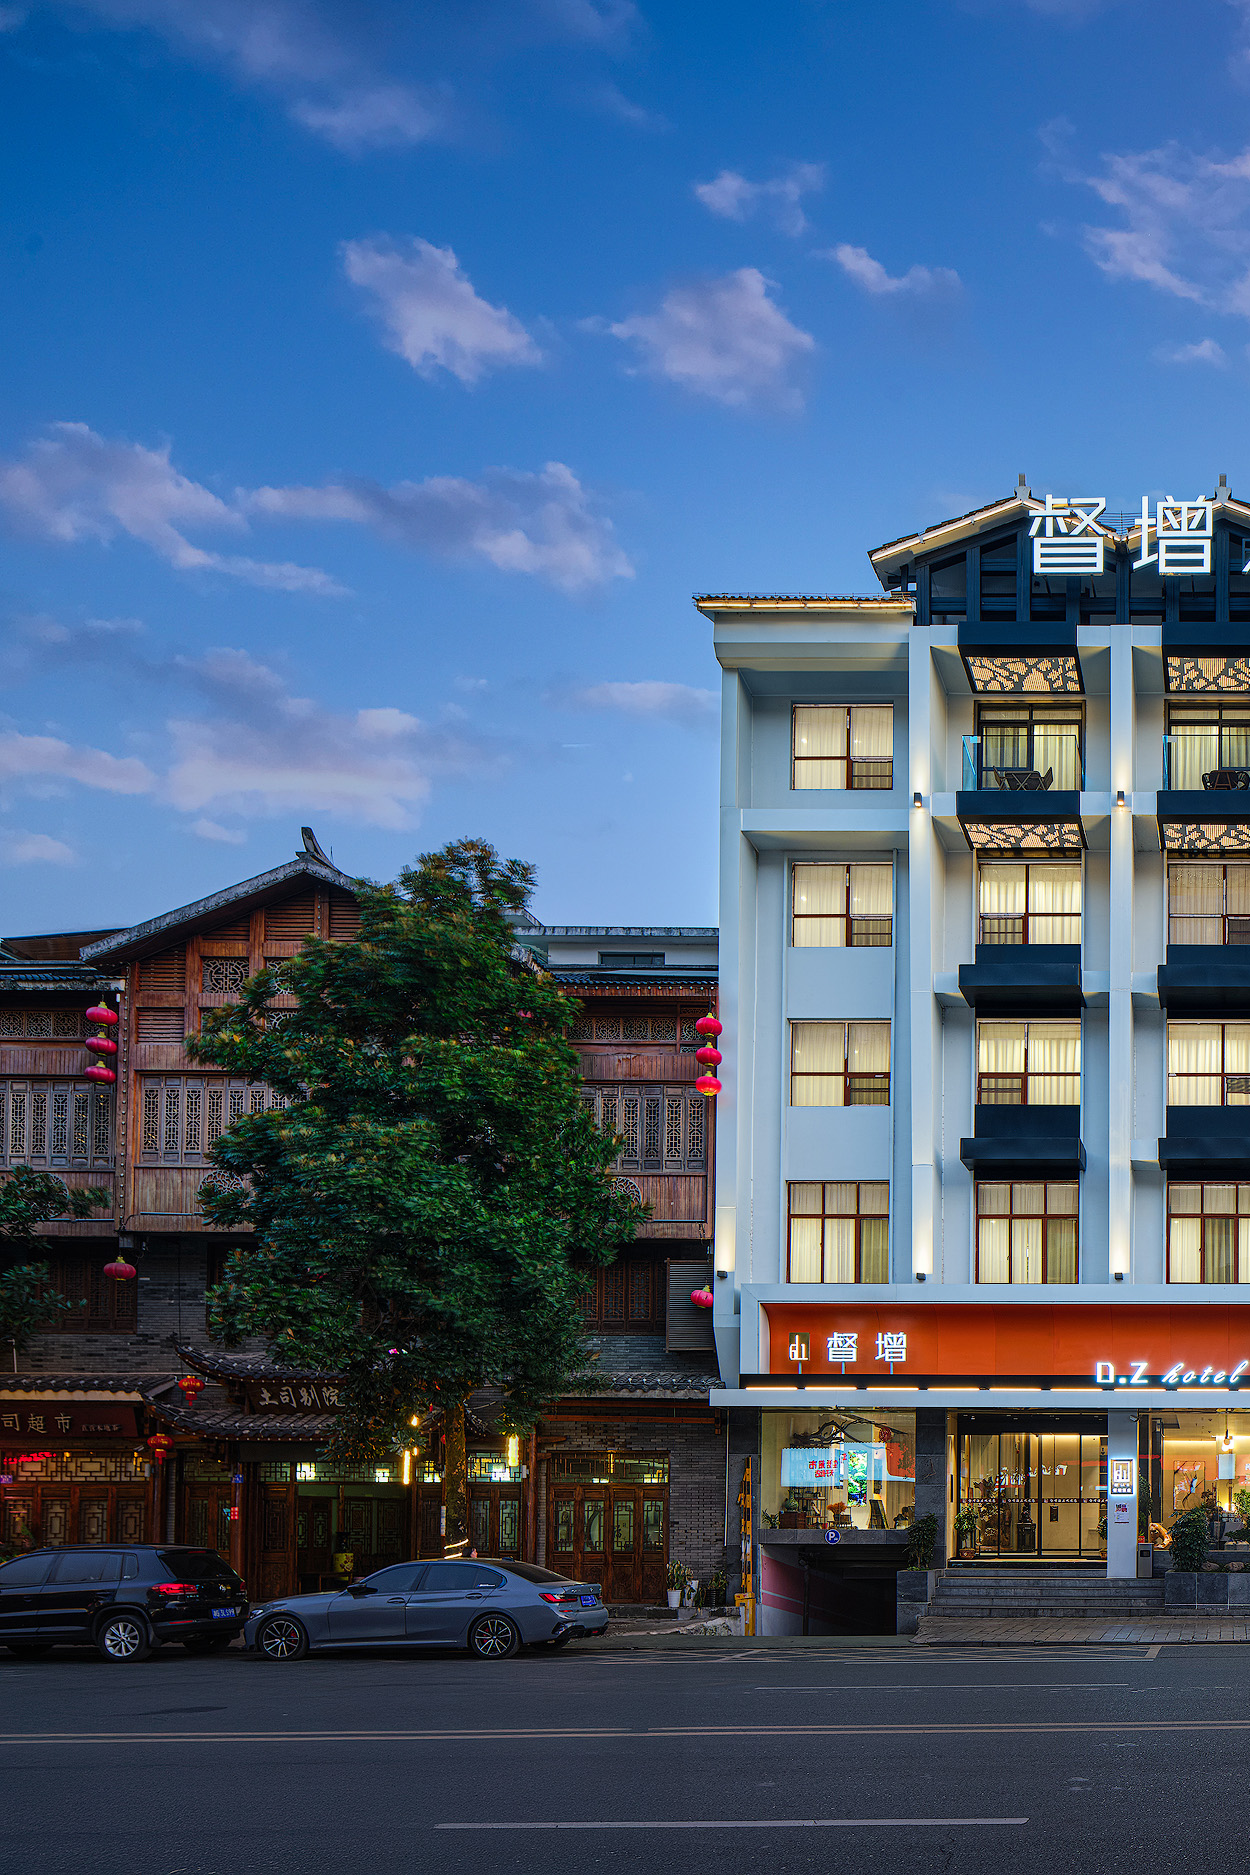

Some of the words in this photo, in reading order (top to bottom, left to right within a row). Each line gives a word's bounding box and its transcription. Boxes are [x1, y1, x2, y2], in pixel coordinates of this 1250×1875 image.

[1028, 494, 1213, 576] 督增
[826, 1331, 908, 1362] 督增
[1096, 1361, 1149, 1384] D.Z
[1161, 1359, 1250, 1384] hotel
